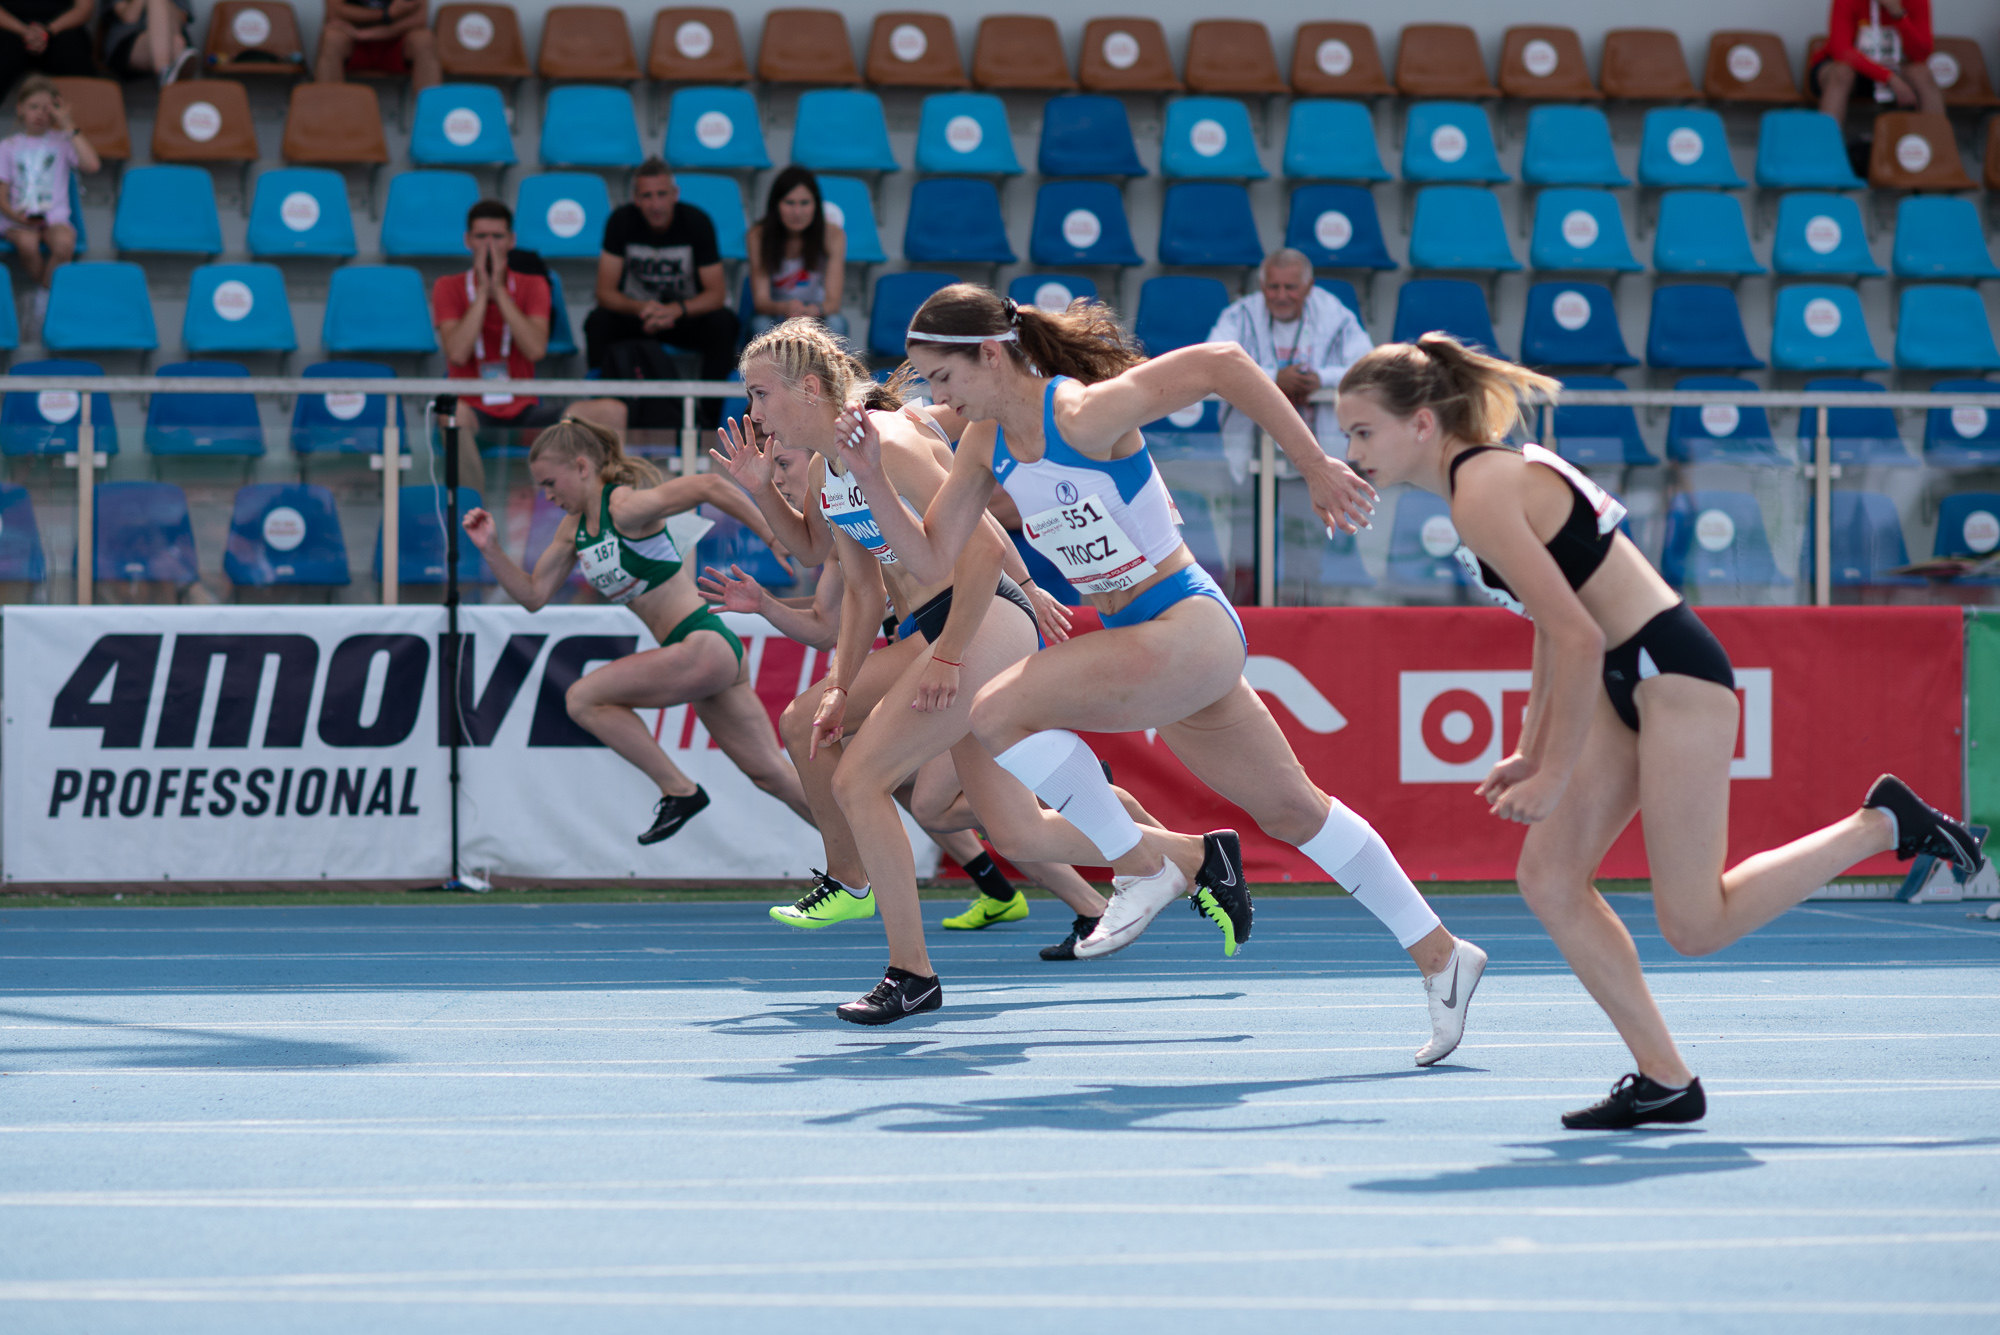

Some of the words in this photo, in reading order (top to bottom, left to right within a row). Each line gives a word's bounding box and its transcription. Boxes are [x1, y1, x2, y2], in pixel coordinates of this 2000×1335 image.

[848, 486, 867, 507] 60
[1061, 501, 1103, 530] 551
[594, 541, 615, 563] 187
[1056, 535, 1118, 566] TKOCZ
[1113, 575, 1133, 589] 021
[48, 767, 421, 818] PROFESSIONAL
